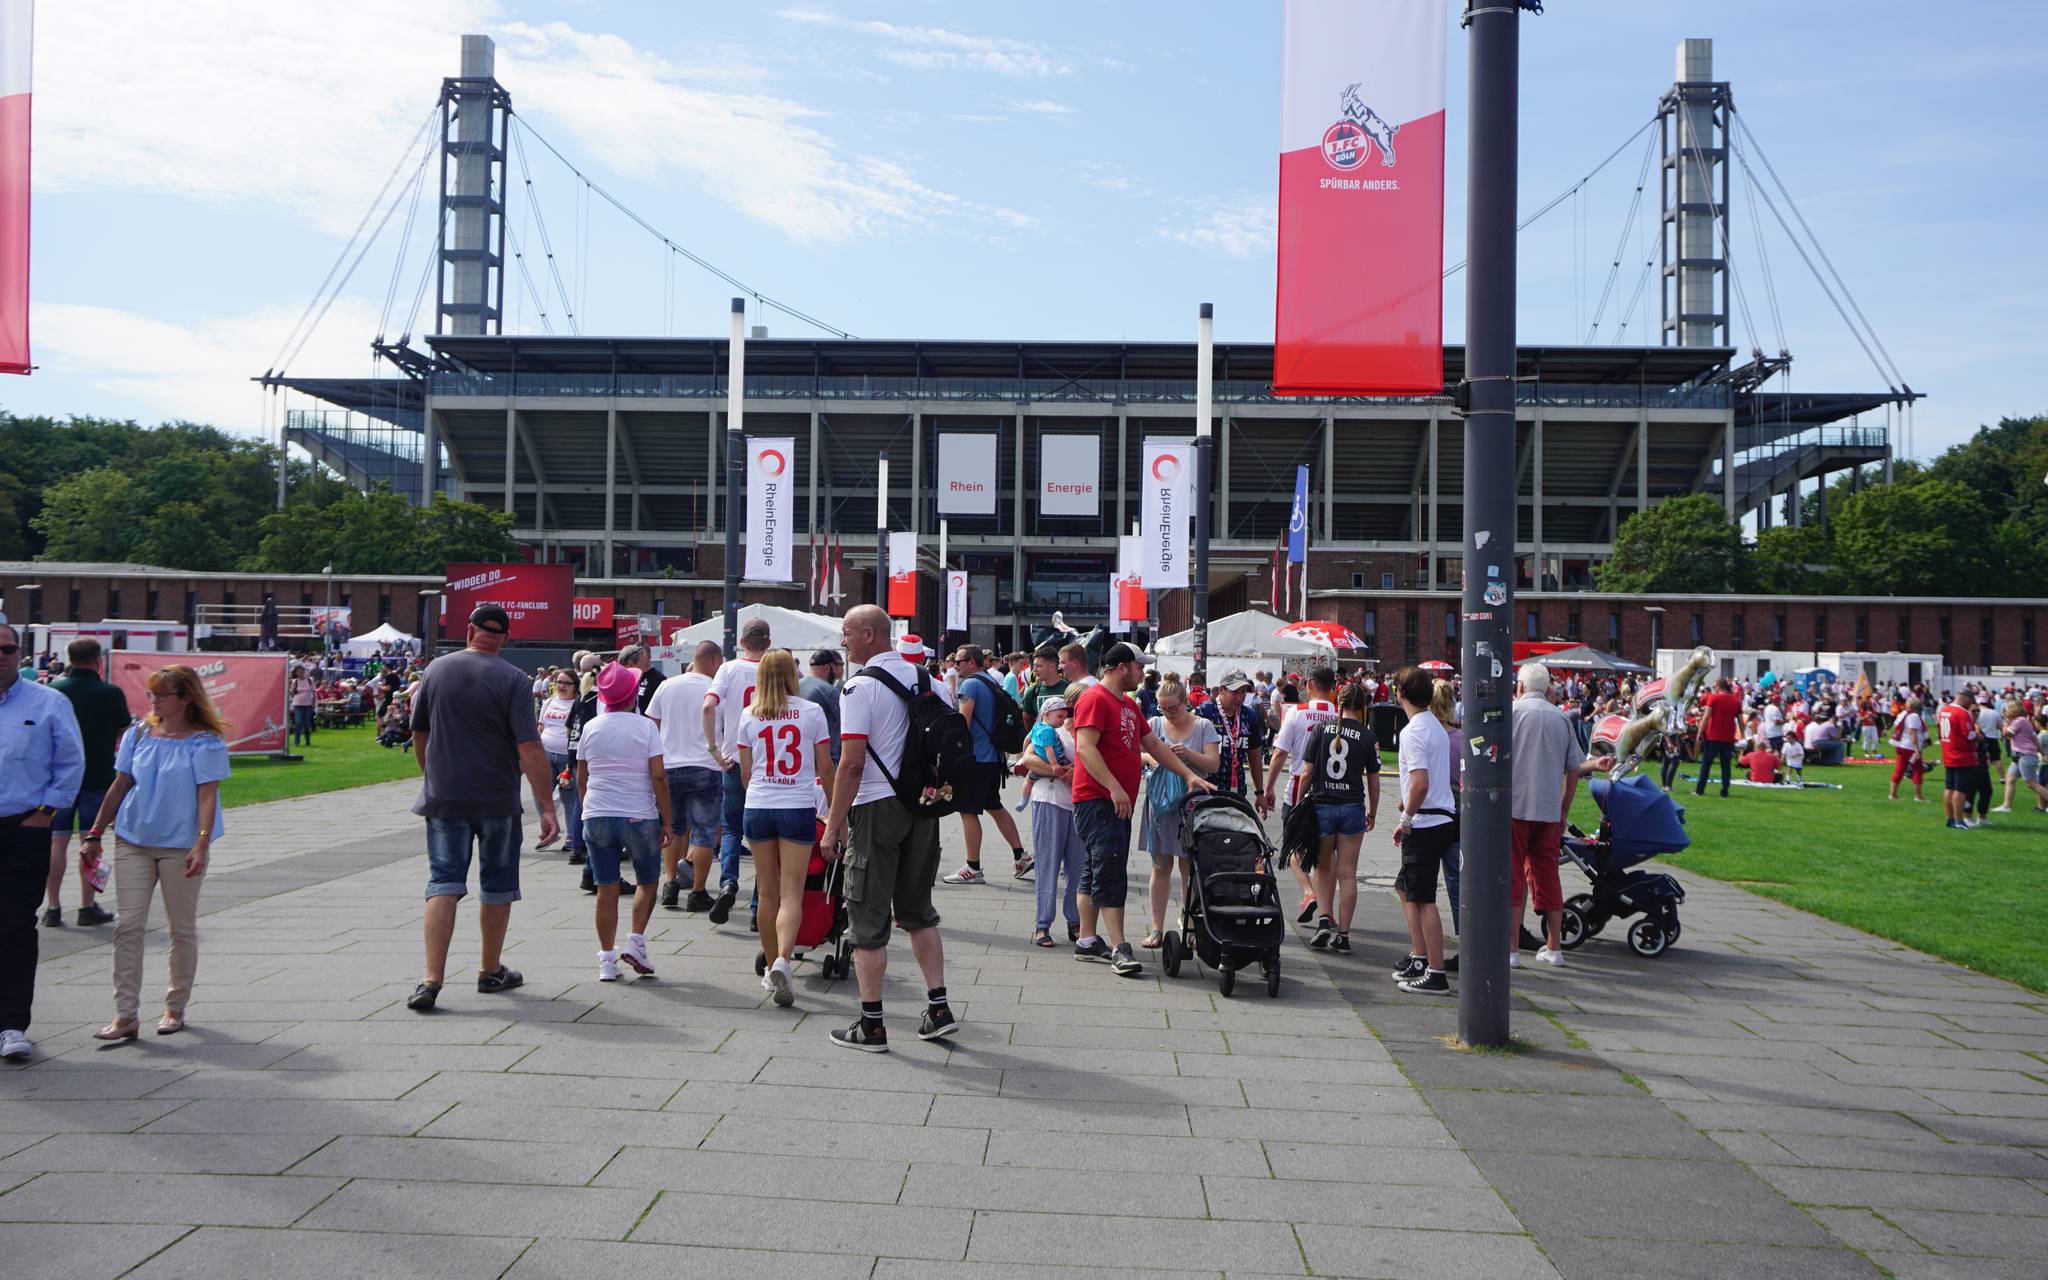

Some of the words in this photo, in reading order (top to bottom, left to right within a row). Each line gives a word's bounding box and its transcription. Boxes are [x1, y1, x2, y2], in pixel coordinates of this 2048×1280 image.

[1335, 150, 1356, 162] KÖLN
[1320, 177, 1360, 190] SPÜRBAR
[1363, 179, 1400, 190] ANDERS.
[950, 481, 983, 492] Rhein
[1047, 482, 1092, 495] Energie
[762, 483, 776, 566] RheinEnergie
[453, 573, 486, 592] WIDDER
[506, 601, 549, 610] FC-FANCLUBS
[572, 604, 601, 620] HOP
[758, 724, 803, 777] 13
[1326, 738, 1349, 780] 8
[1336, 781, 1350, 791] KÖLN
